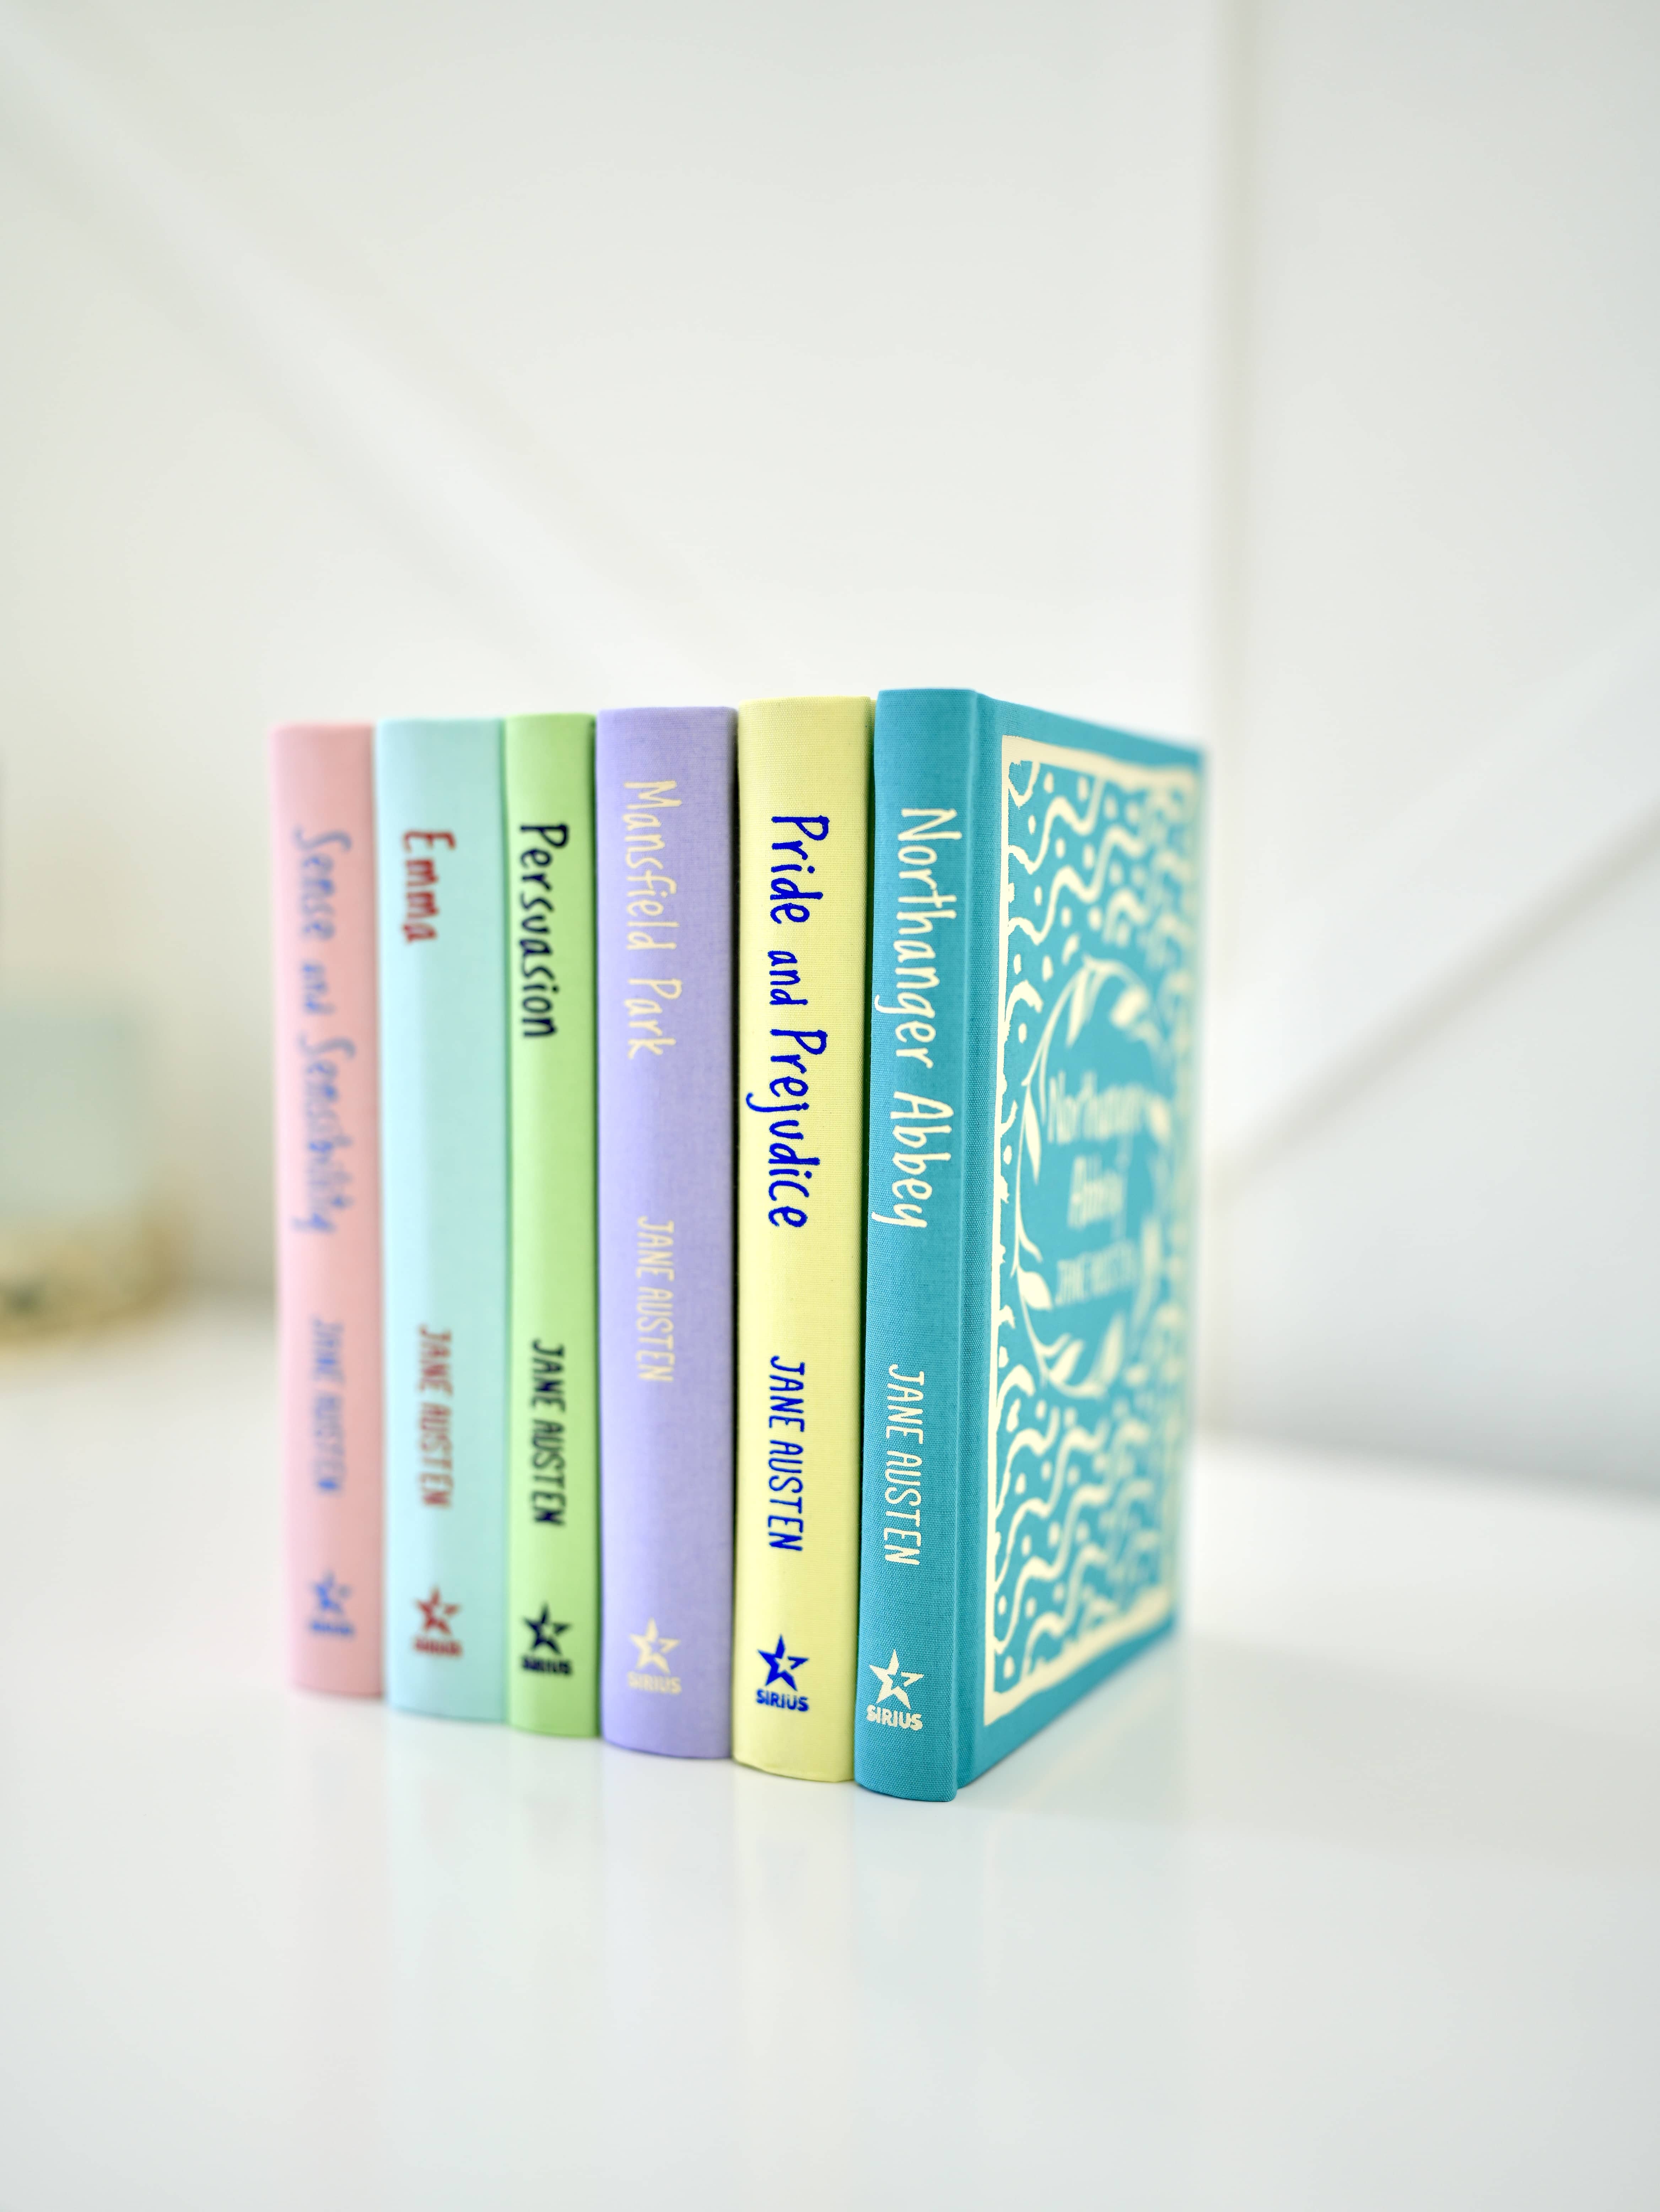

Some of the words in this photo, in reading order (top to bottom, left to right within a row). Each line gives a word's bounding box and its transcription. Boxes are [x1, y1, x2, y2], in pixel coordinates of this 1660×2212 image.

[291, 826, 354, 942] Sense
[401, 829, 456, 944] Emma
[622, 780, 683, 950] Mansfield
[770, 815, 830, 924] Pride
[519, 822, 570, 1040] Persuasion
[767, 950, 808, 1006] and
[874, 807, 963, 1069] Northanger
[301, 960, 335, 1016] and
[624, 977, 683, 1059] Park
[291, 1032, 357, 1235] Sensibility
[745, 1029, 828, 1228] Prejudice
[872, 1090, 955, 1229] Abbey
[636, 1216, 675, 1281] JANE
[310, 1315, 344, 1385] JANE
[418, 1323, 453, 1395] JANE
[531, 1338, 566, 1413] JANE
[636, 1286, 675, 1382] AUSTEN
[312, 1389, 346, 1495] AUSTEN
[768, 1355, 805, 1432] JANE
[886, 1364, 924, 1444] JANE
[419, 1401, 454, 1508] AUSTEN
[530, 1419, 566, 1528] AUSTEN
[767, 1440, 804, 1551] AUSTEN
[883, 1451, 922, 1565] AUSTEN
[627, 1671, 682, 1695] SIRIUS
[756, 1689, 809, 1712] SIRIUS
[866, 1705, 923, 1731] SIRIUS
